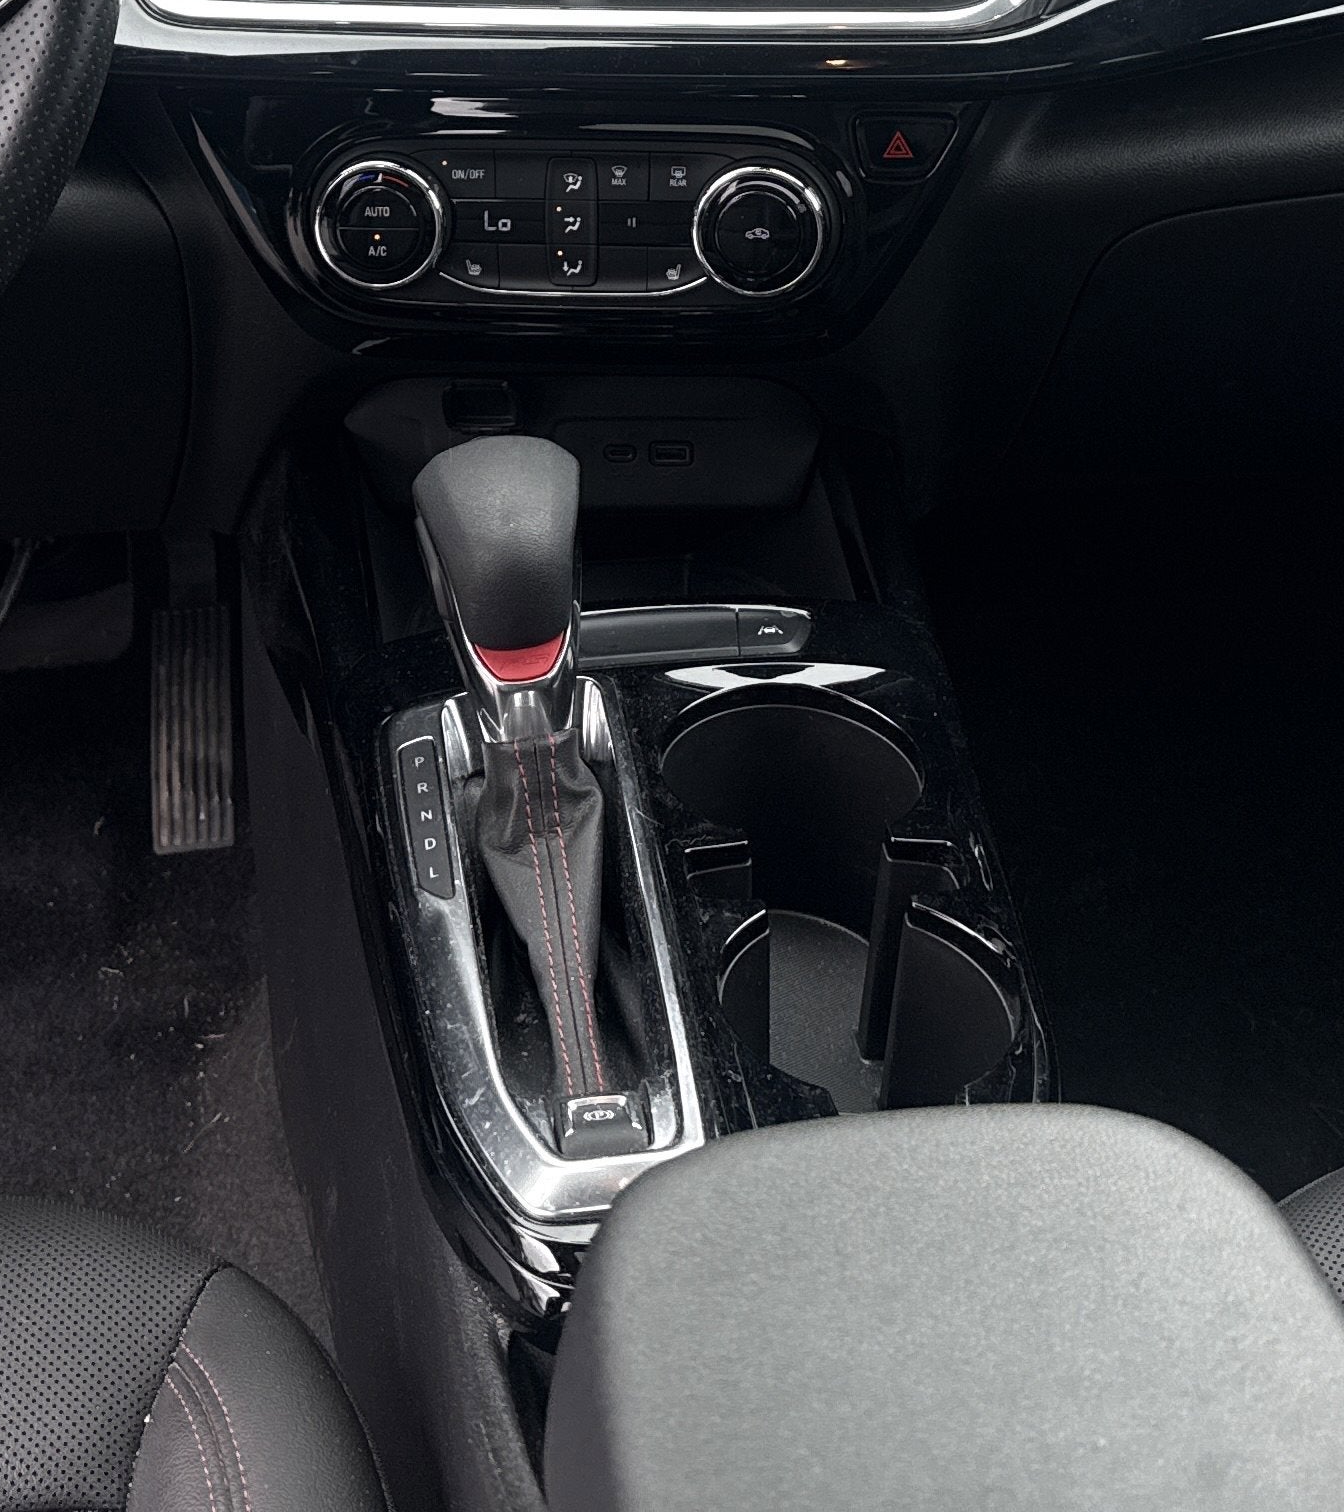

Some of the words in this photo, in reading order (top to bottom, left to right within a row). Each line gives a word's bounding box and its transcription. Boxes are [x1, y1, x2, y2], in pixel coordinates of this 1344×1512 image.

[451, 169, 485, 180] ON/OFF
[611, 178, 627, 186] MAX
[669, 178, 687, 187] REAR
[364, 206, 390, 217] AUTO
[368, 245, 387, 256] A/C
[414, 757, 425, 768] P
[417, 782, 428, 793] R
[421, 810, 432, 821] N
[424, 837, 436, 850] D
[429, 866, 439, 879] L
